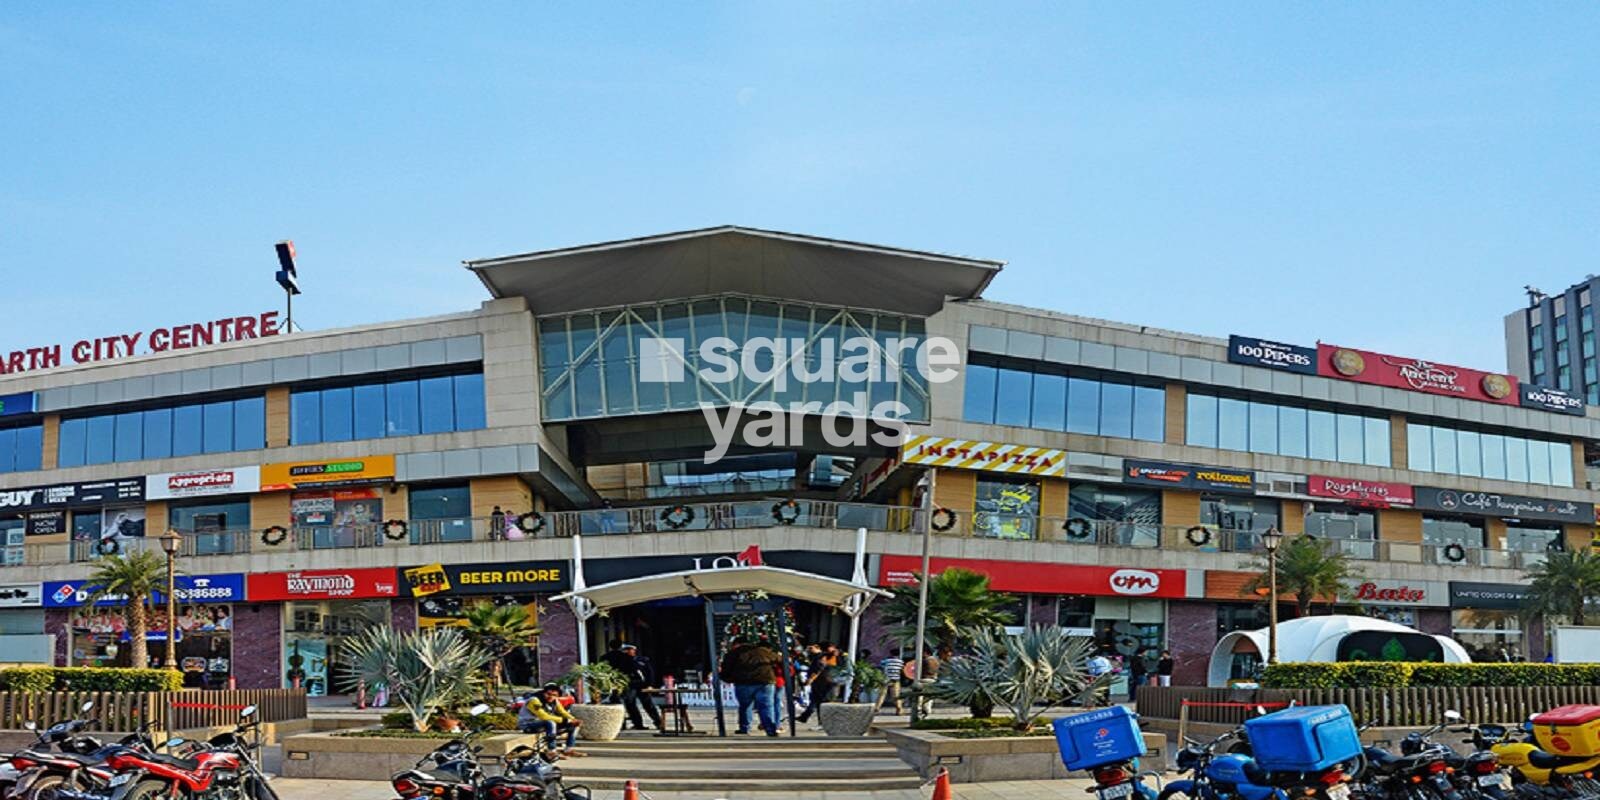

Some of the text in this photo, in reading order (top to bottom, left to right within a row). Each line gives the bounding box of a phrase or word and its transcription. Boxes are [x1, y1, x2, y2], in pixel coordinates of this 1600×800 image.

[71, 332, 142, 364] CITY
[149, 310, 279, 352] CENTRE
[1238, 345, 1263, 358] 100
[1400, 367, 1455, 385] Ancient
[1528, 391, 1546, 403] 100
[918, 444, 1053, 472] INSTAPIZZA
[0, 490, 35, 506] GUY
[460, 569, 560, 585] BEER MORE
[174, 587, 233, 600] 86888
[1355, 582, 1425, 601] Bata
